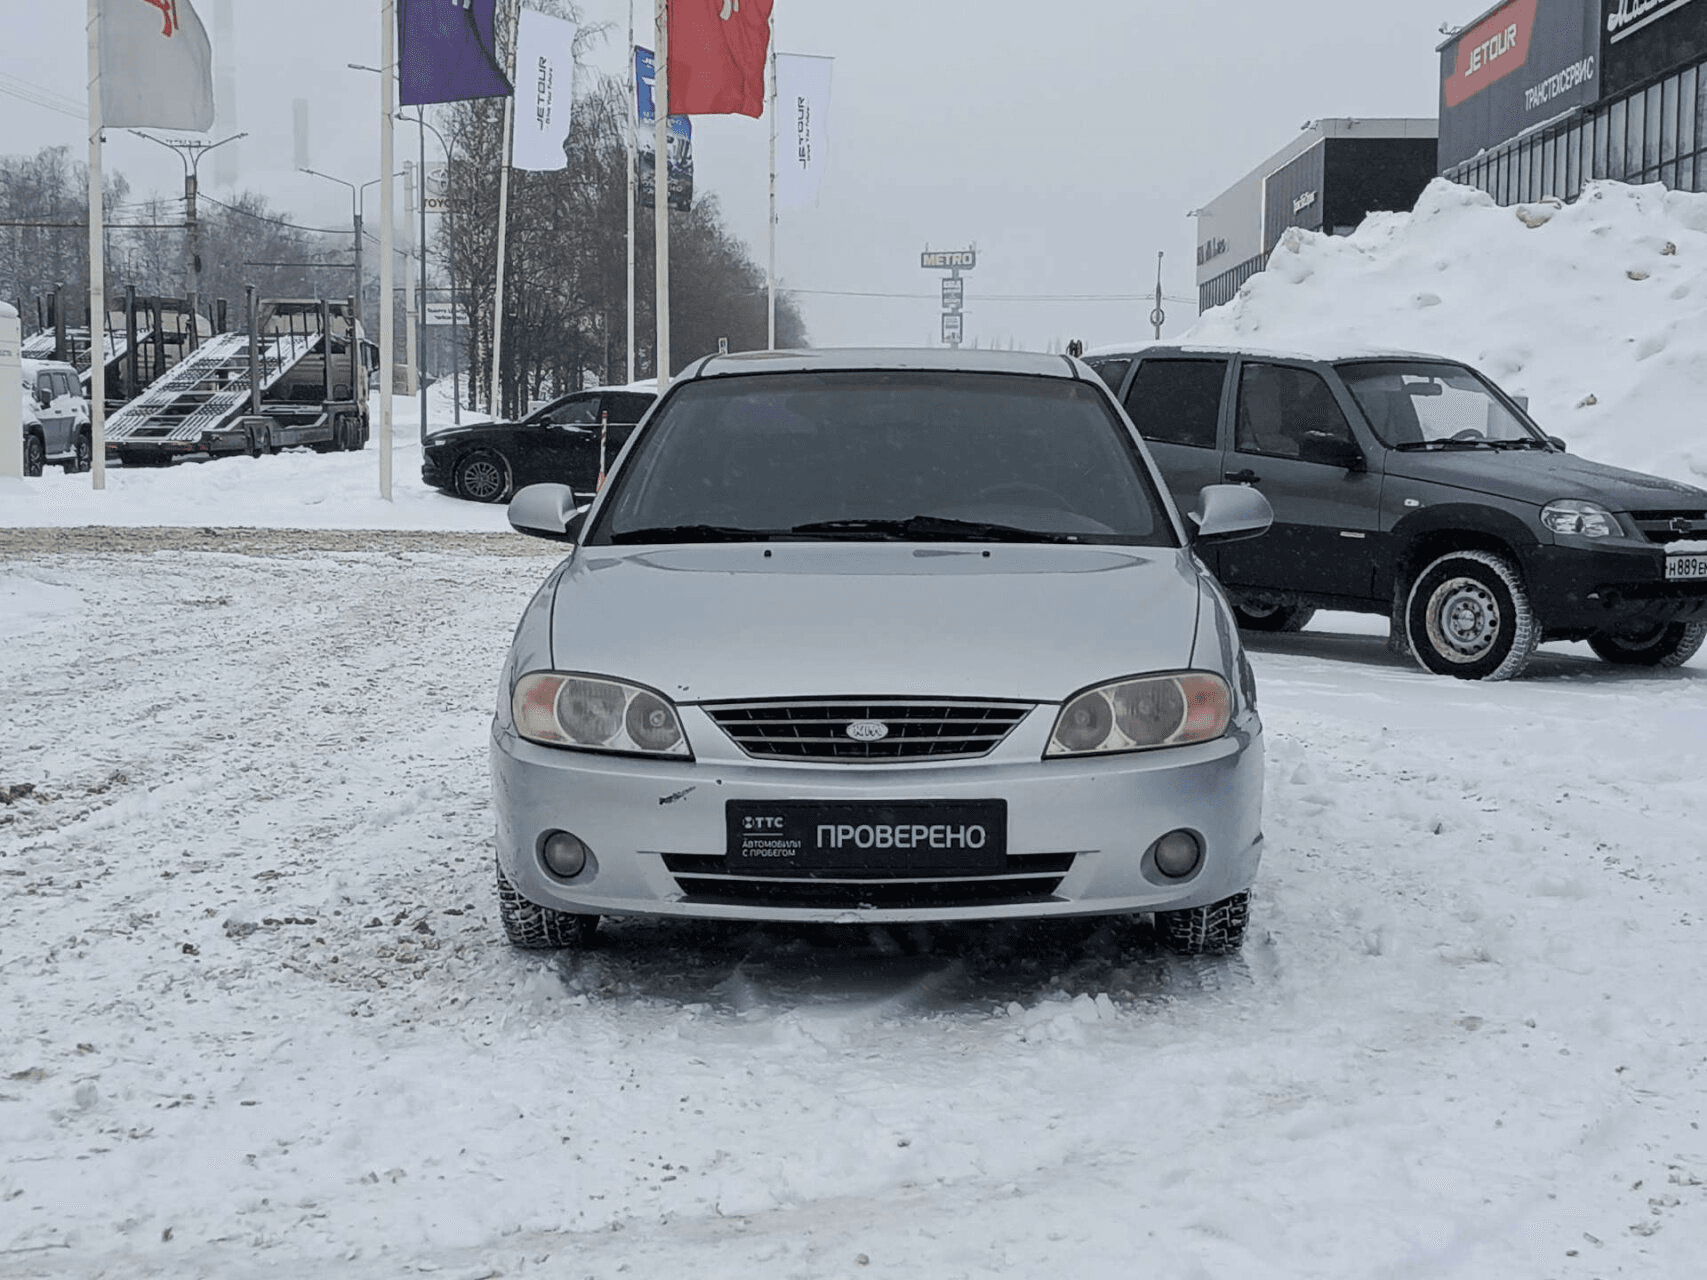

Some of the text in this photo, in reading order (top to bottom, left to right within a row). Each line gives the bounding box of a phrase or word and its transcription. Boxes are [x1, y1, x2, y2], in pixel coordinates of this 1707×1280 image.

[1465, 23, 1517, 77] JETOUR
[537, 56, 546, 131] JETOUR
[1524, 55, 1594, 111] ТРАНСТЕХСЕРВИС
[797, 96, 806, 170] JETOUR
[924, 254, 970, 265] METRO
[742, 839, 802, 849] АВТОМОБИЛИ
[750, 848, 796, 858] ПРОБЕГОМ
[816, 824, 986, 849] ПРОВЕРЕНО
